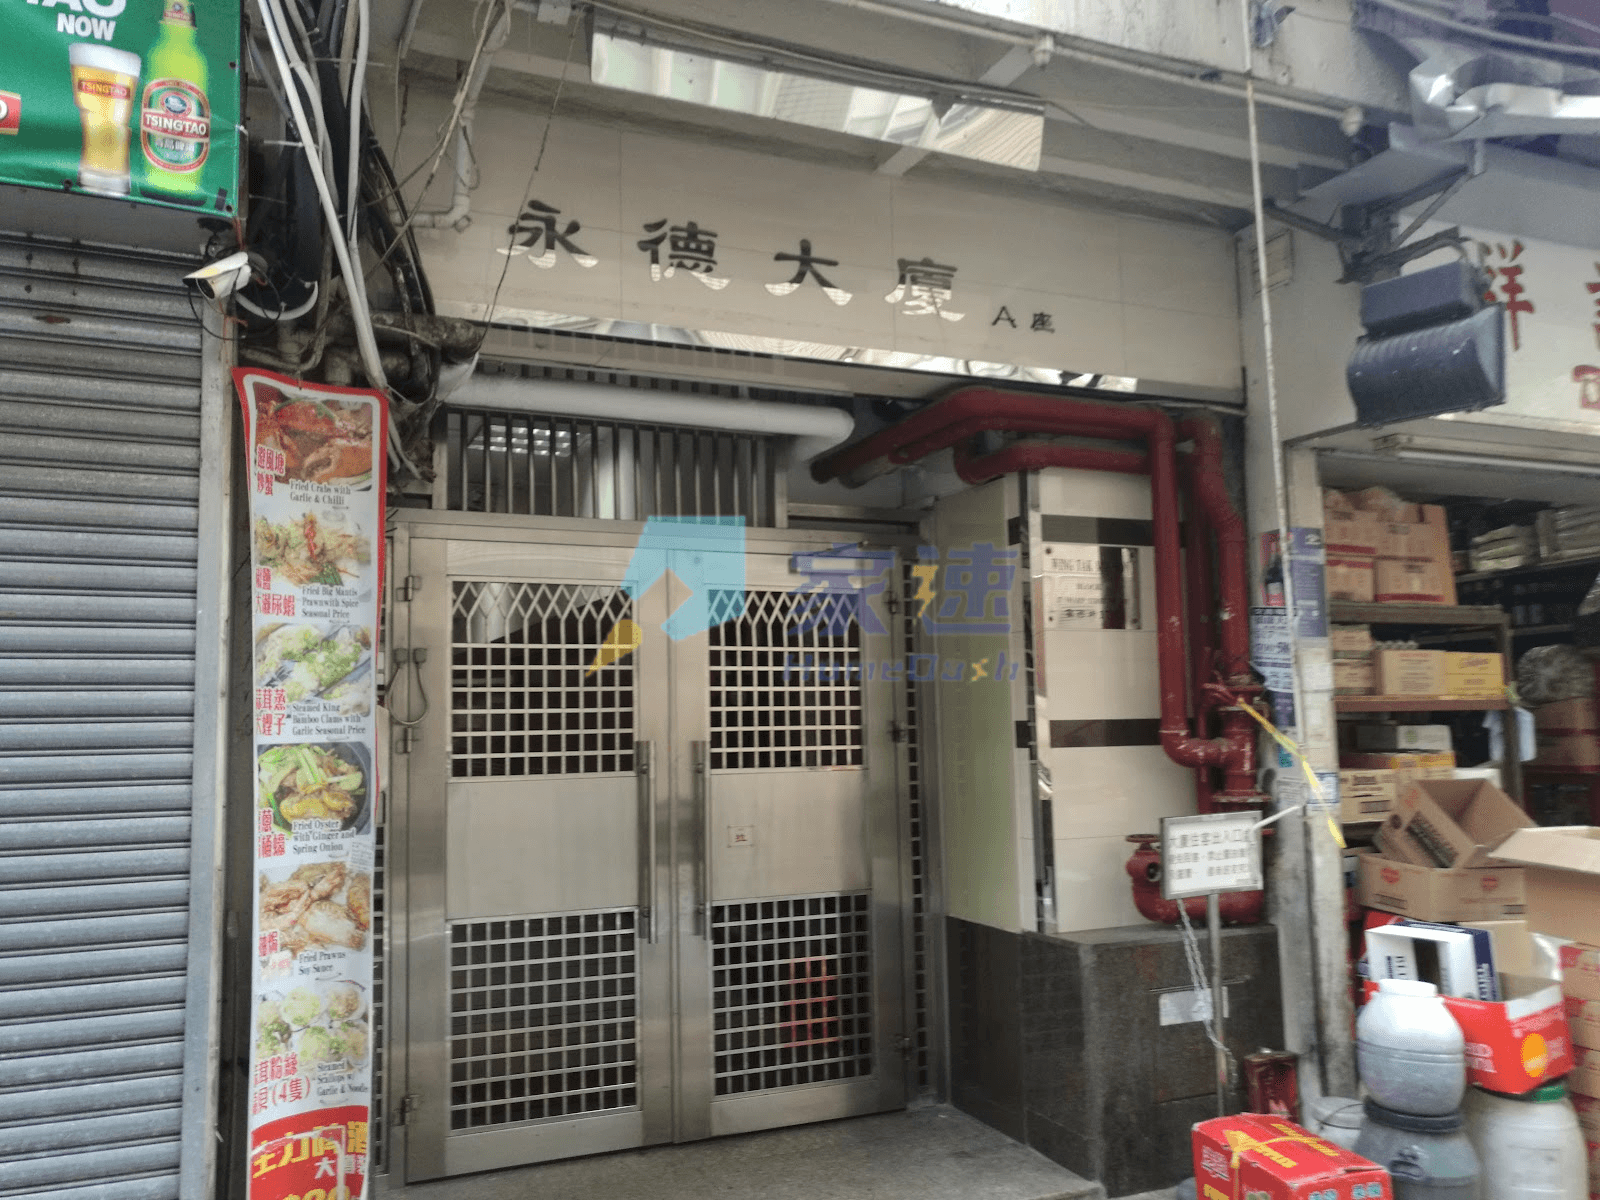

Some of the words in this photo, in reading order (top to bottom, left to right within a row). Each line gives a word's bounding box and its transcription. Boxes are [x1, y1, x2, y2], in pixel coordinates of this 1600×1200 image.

[57, 12, 116, 41] NOW
[145, 113, 207, 136] TSINGTAO
[290, 481, 309, 493] Fried
[311, 482, 332, 495] Crabs
[334, 484, 351, 496] with
[290, 492, 312, 503] Garlic
[322, 493, 345, 506] Chilli
[302, 585, 319, 597] Fried
[320, 586, 333, 599] Big
[335, 586, 358, 598] Mantis
[341, 598, 359, 610] Spice
[302, 606, 331, 618] Seasonal
[332, 607, 350, 619] Price
[293, 702, 321, 713] Steamed
[323, 702, 341, 715] King
[292, 713, 319, 725] Bamboo
[321, 713, 344, 724] Clams
[345, 713, 361, 724] with
[292, 724, 314, 736] Garlic
[315, 724, 346, 736] Seasonal
[348, 724, 366, 735] Price
[293, 819, 312, 832] Fried
[314, 818, 340, 833] Oyster
[293, 830, 311, 842] with
[312, 830, 340, 843] Ginger
[341, 829, 356, 840] and
[293, 842, 318, 856] Spring
[320, 841, 344, 852] Onion
[299, 951, 318, 963] Fried
[320, 949, 347, 961] Prawns
[299, 964, 311, 976] Soy
[312, 963, 334, 974] Sauce
